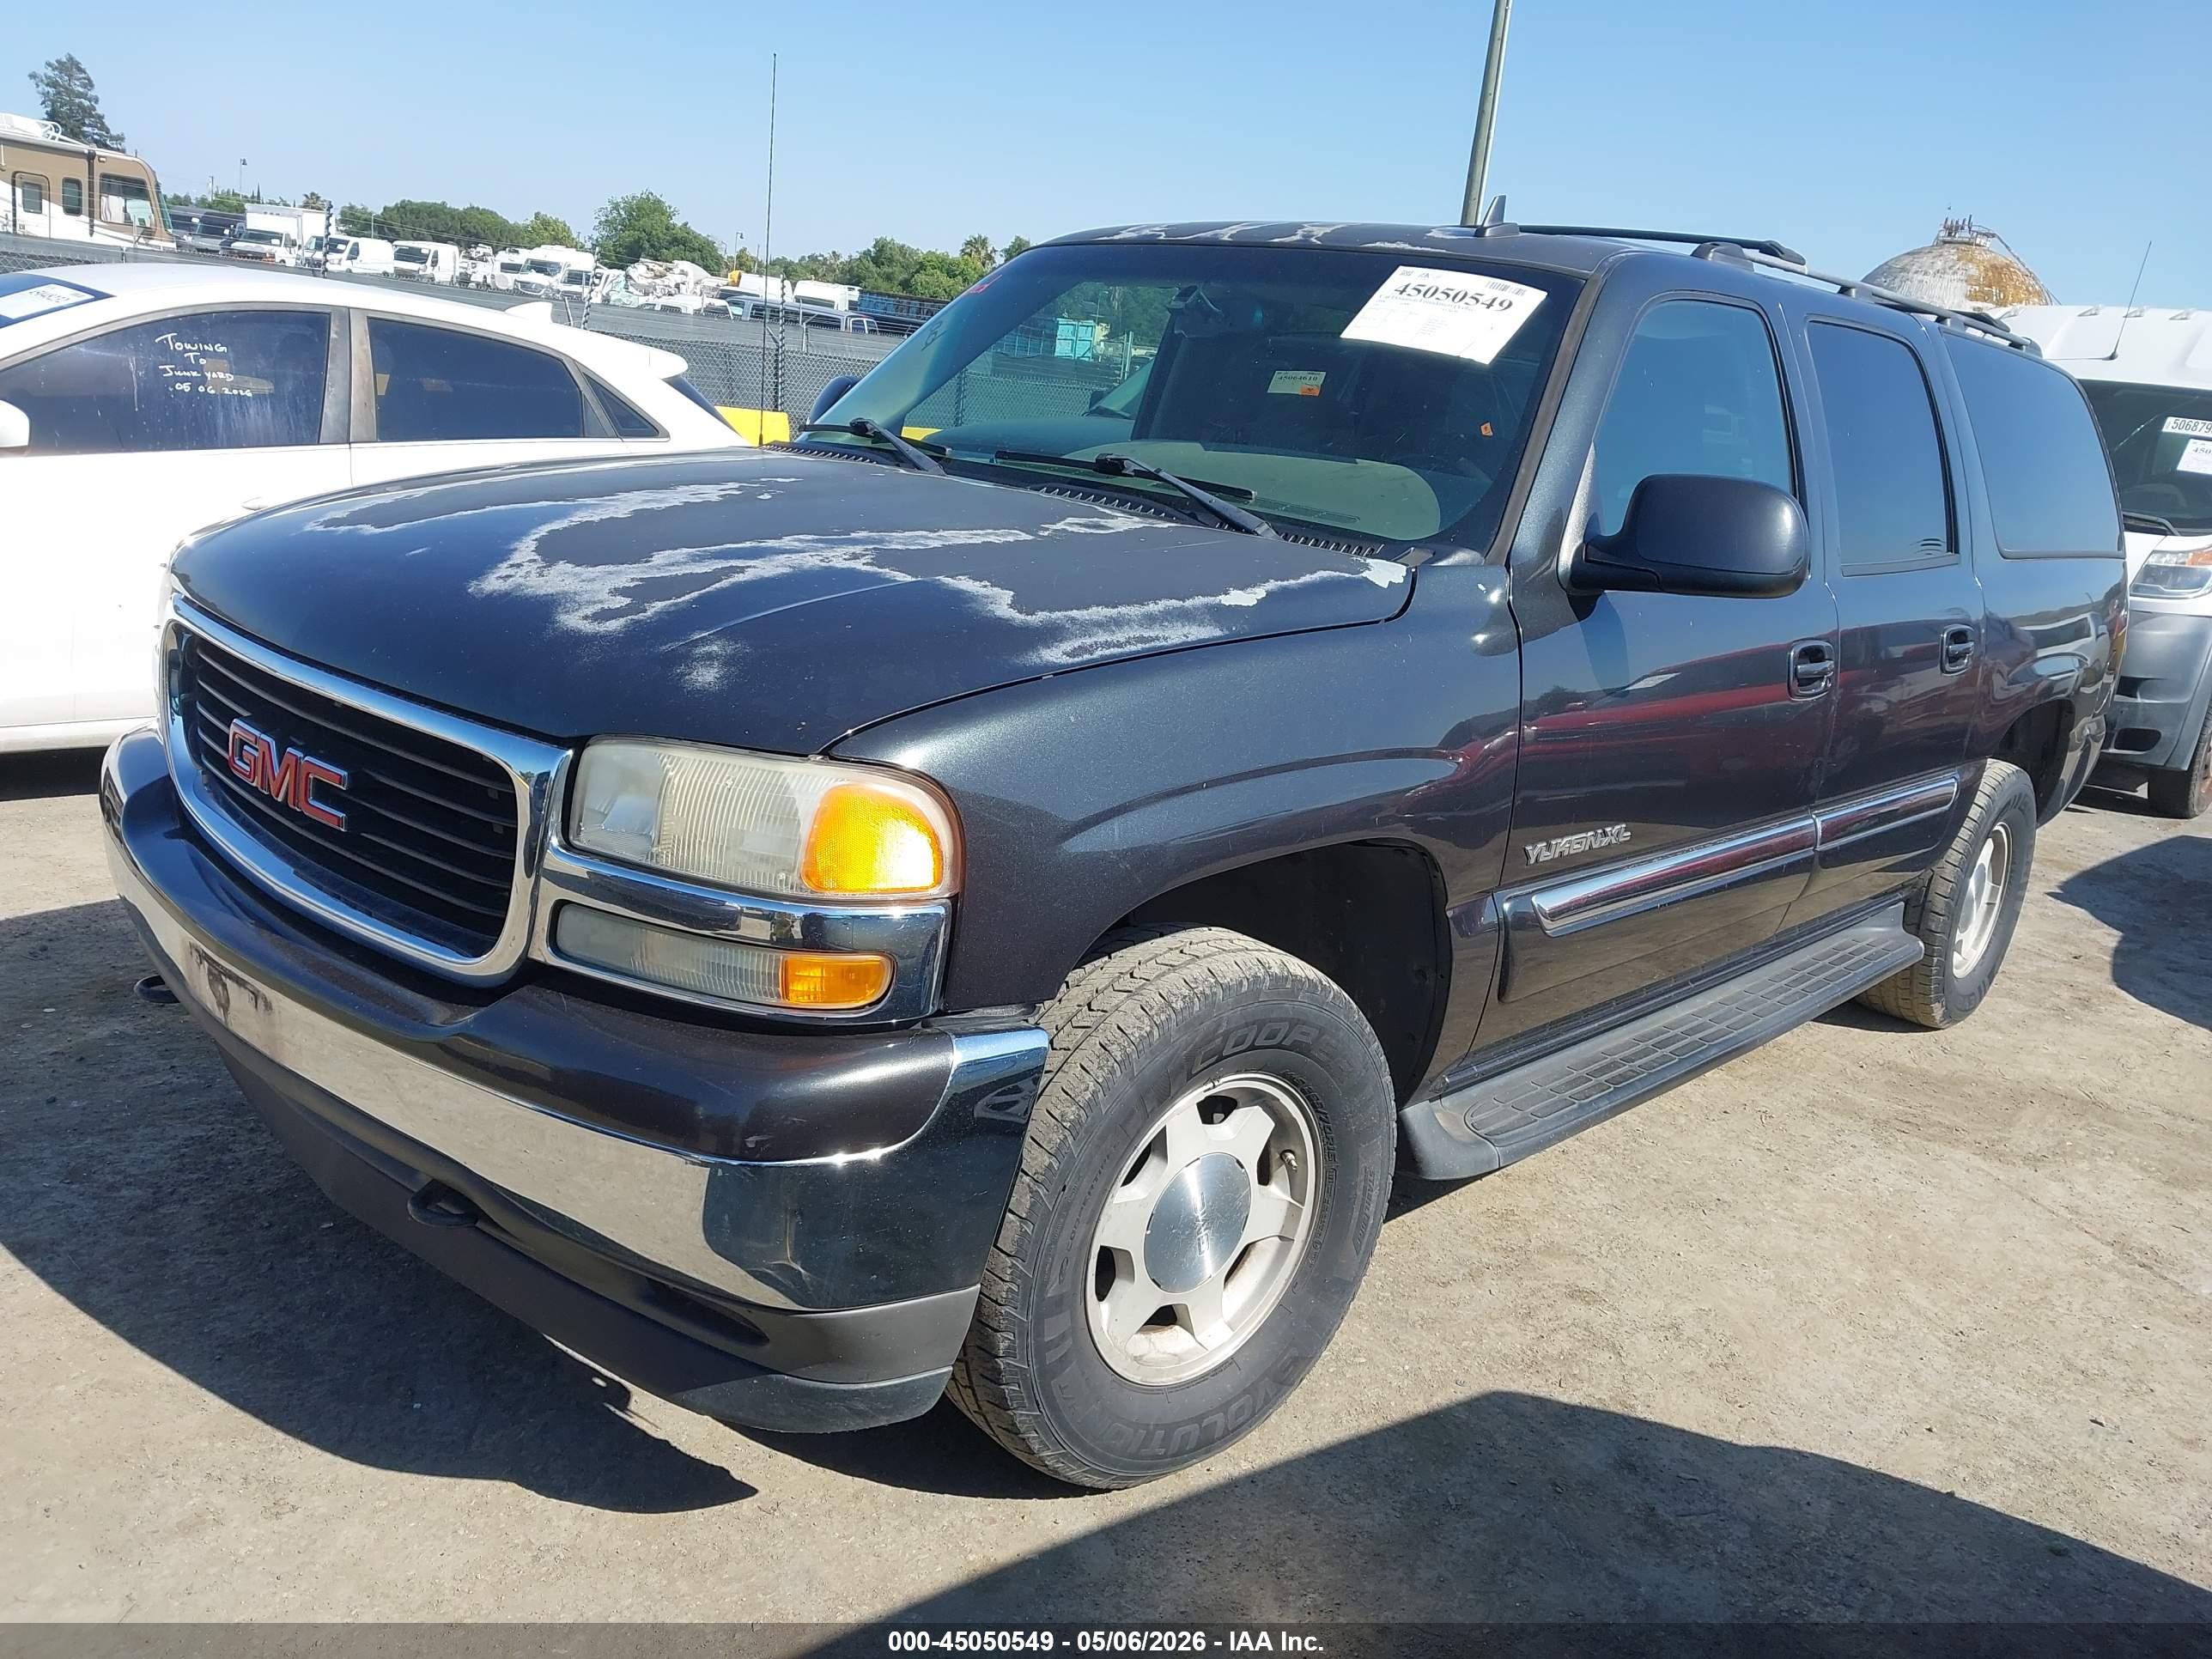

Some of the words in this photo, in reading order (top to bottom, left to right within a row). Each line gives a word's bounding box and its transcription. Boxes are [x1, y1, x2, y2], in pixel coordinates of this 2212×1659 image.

[1394, 283, 1514, 312] 45050549
[155, 332, 228, 353] TOWING
[184, 352, 207, 364] TO
[204, 371, 234, 381] YARD
[2171, 419, 2212, 434] 506879
[228, 718, 349, 832] GMC
[1191, 1022, 1344, 1075] COOPE
[1193, 1191, 1210, 1257] GMC
